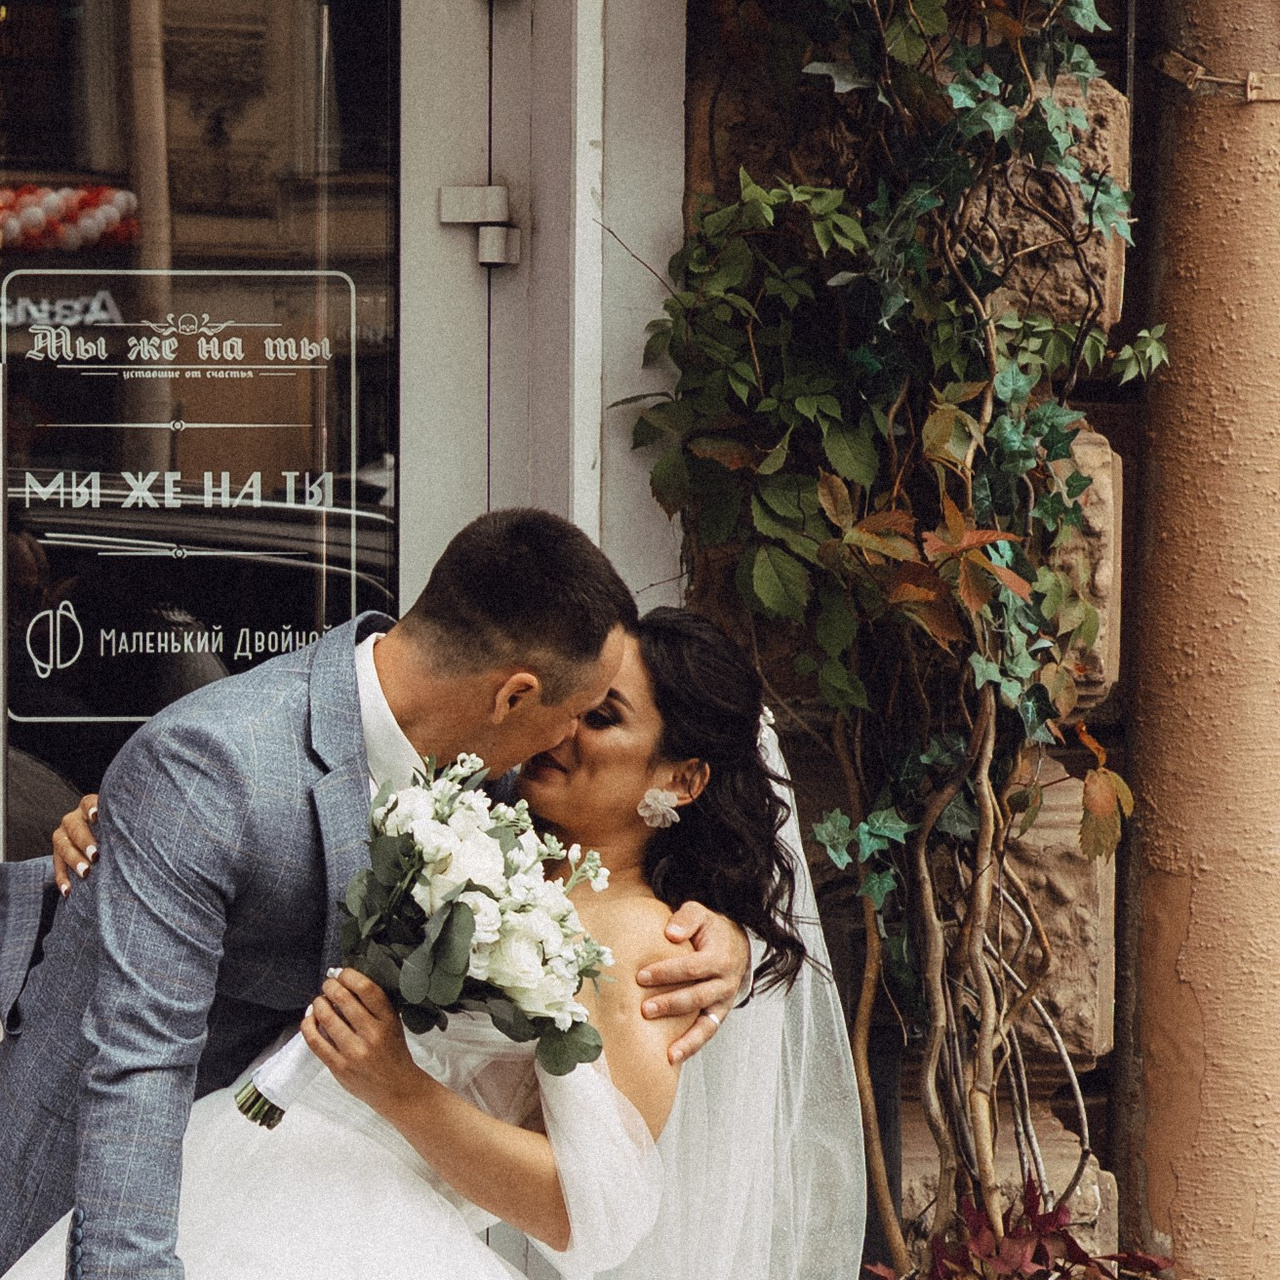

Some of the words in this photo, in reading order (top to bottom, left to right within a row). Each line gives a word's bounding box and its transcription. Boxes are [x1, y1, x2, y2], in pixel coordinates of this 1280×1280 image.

[25, 324, 108, 361] Мы
[127, 336, 178, 360] же
[198, 336, 244, 360] на
[263, 336, 333, 360] ты
[123, 370, 180, 380] уставшие
[185, 370, 201, 378] от
[206, 370, 253, 378] счастья
[25, 471, 100, 508] МЫ
[121, 471, 181, 508] ЖЕ
[204, 471, 261, 508] НА
[282, 471, 333, 508] ТЫ
